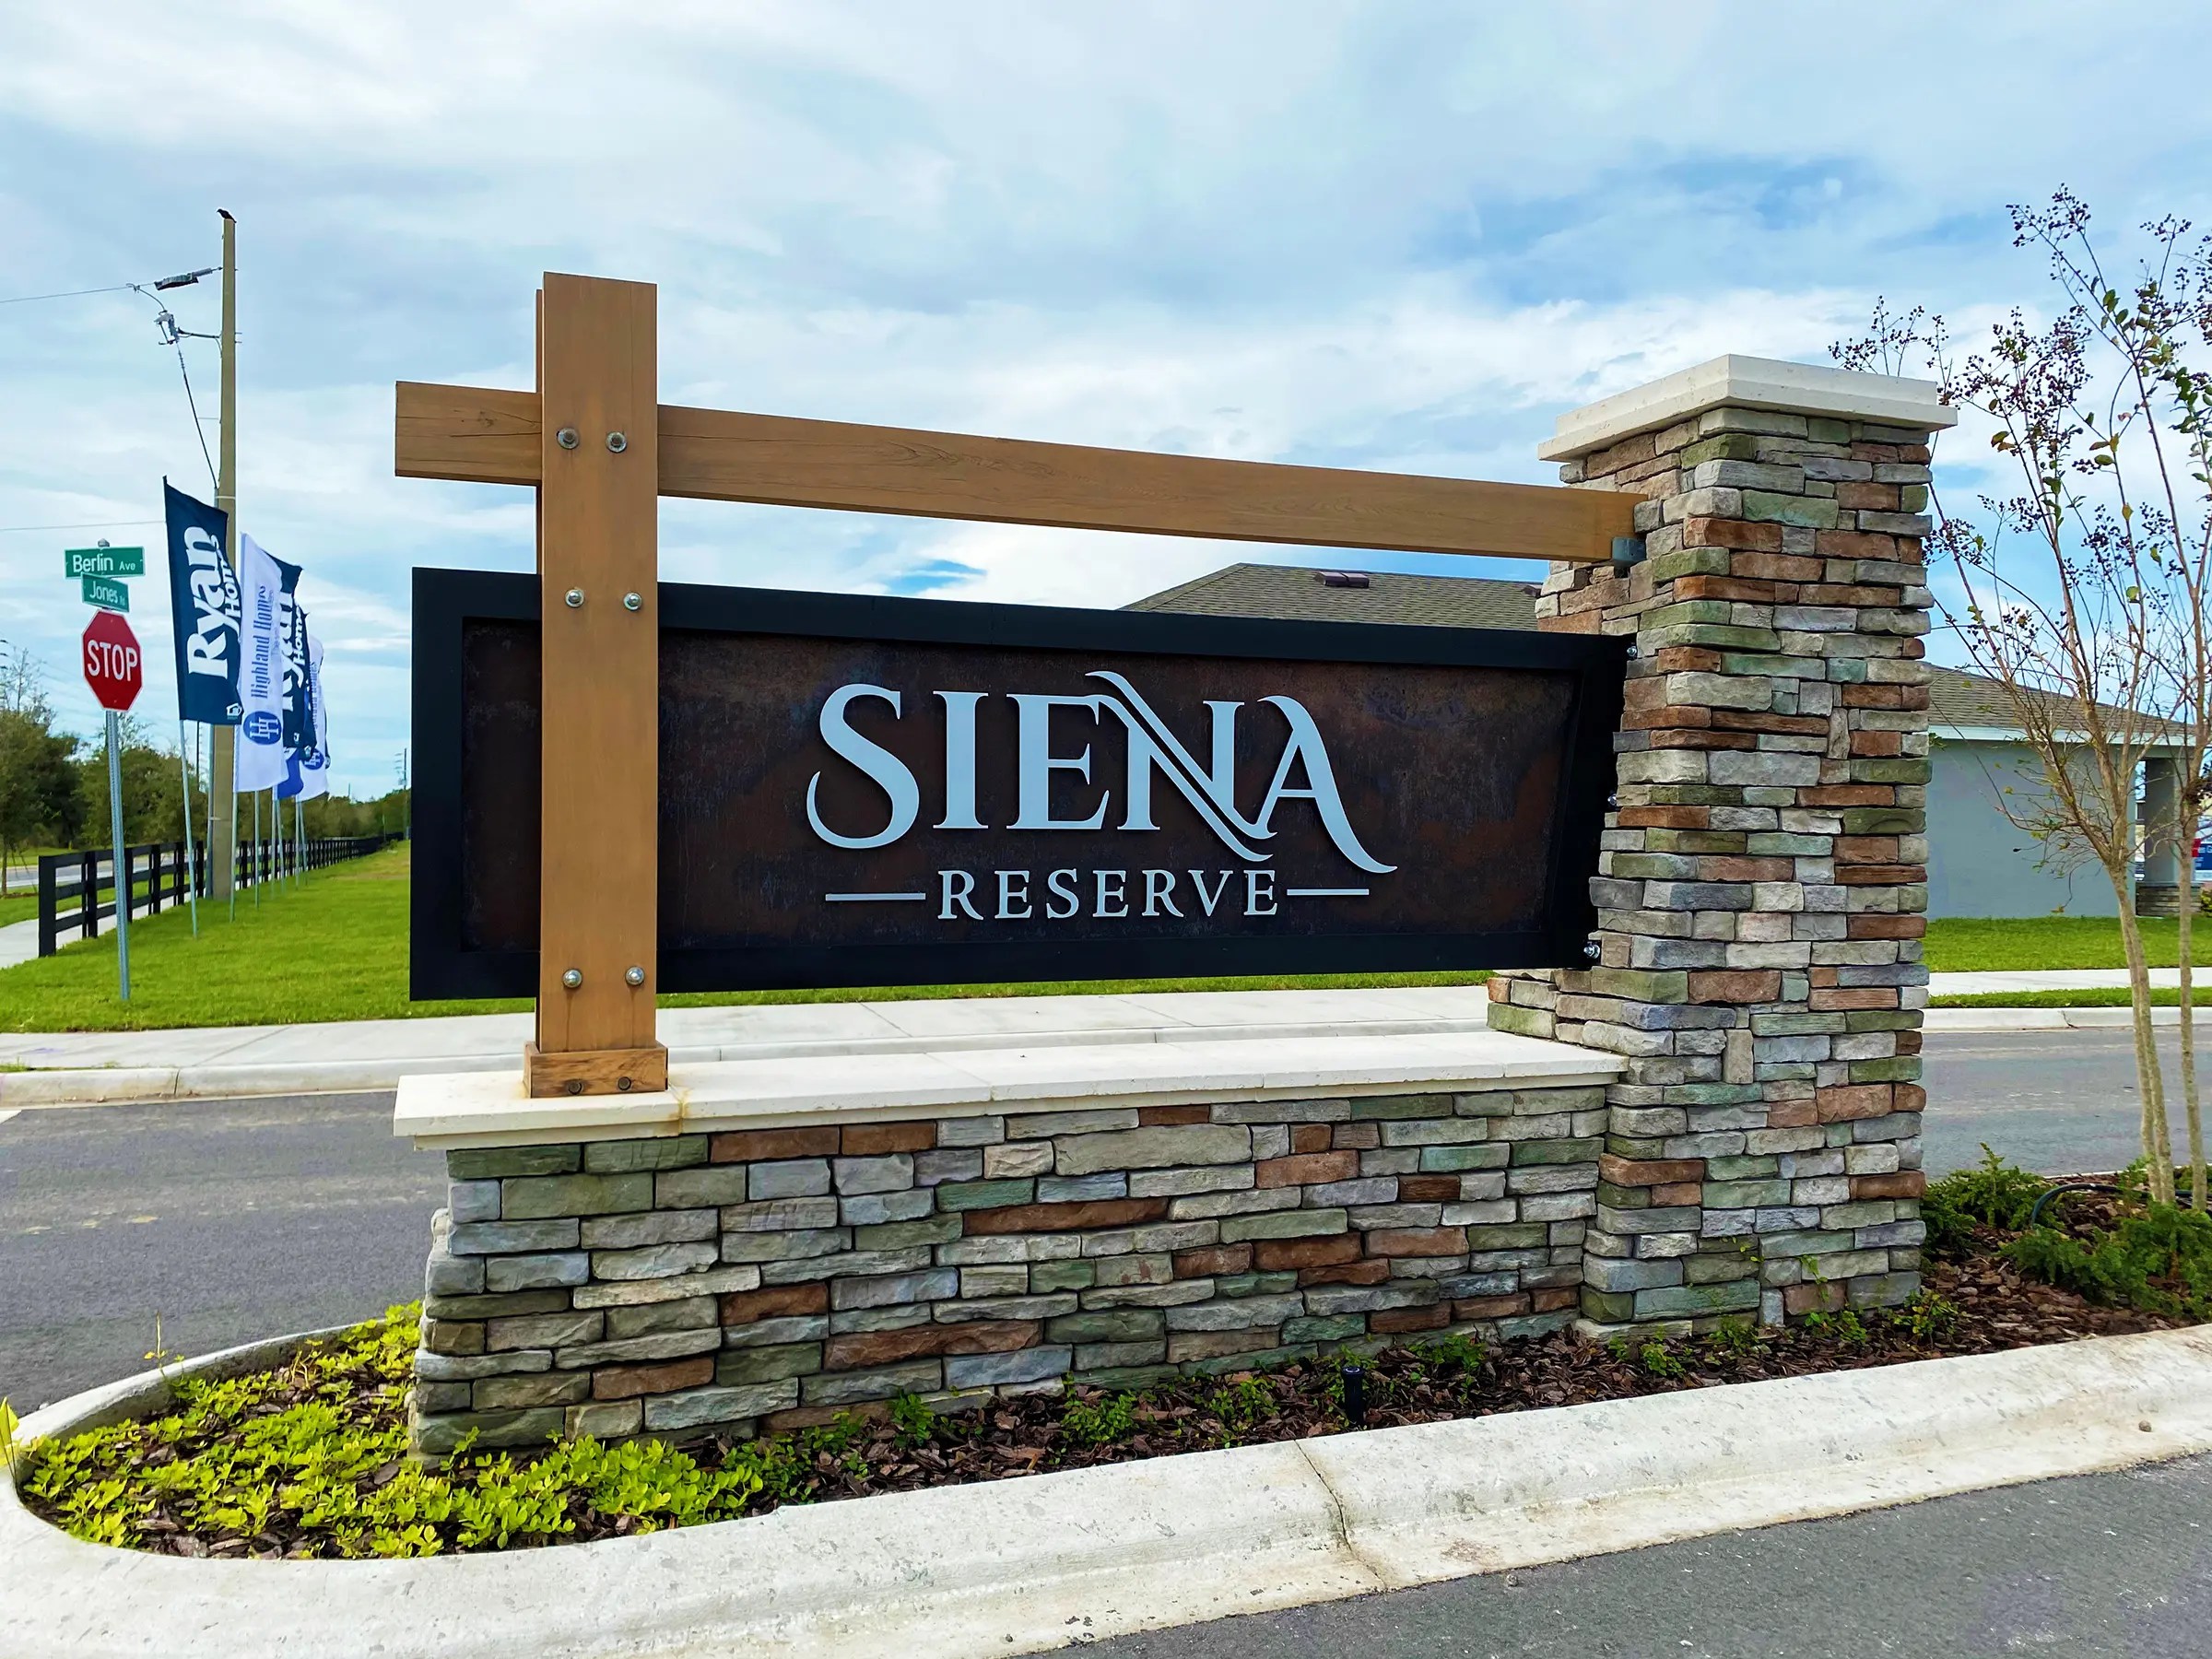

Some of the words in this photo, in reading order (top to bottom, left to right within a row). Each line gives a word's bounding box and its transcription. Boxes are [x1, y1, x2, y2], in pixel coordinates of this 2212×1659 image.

[72, 553, 114, 573] Berlin
[119, 560, 136, 571] Ave
[89, 581, 119, 604] Jones
[183, 526, 241, 680] Ryan
[87, 639, 138, 682] STOP
[250, 636, 271, 700] Highland
[806, 670, 1398, 875] SIENA
[936, 868, 1279, 921] RESERVE
